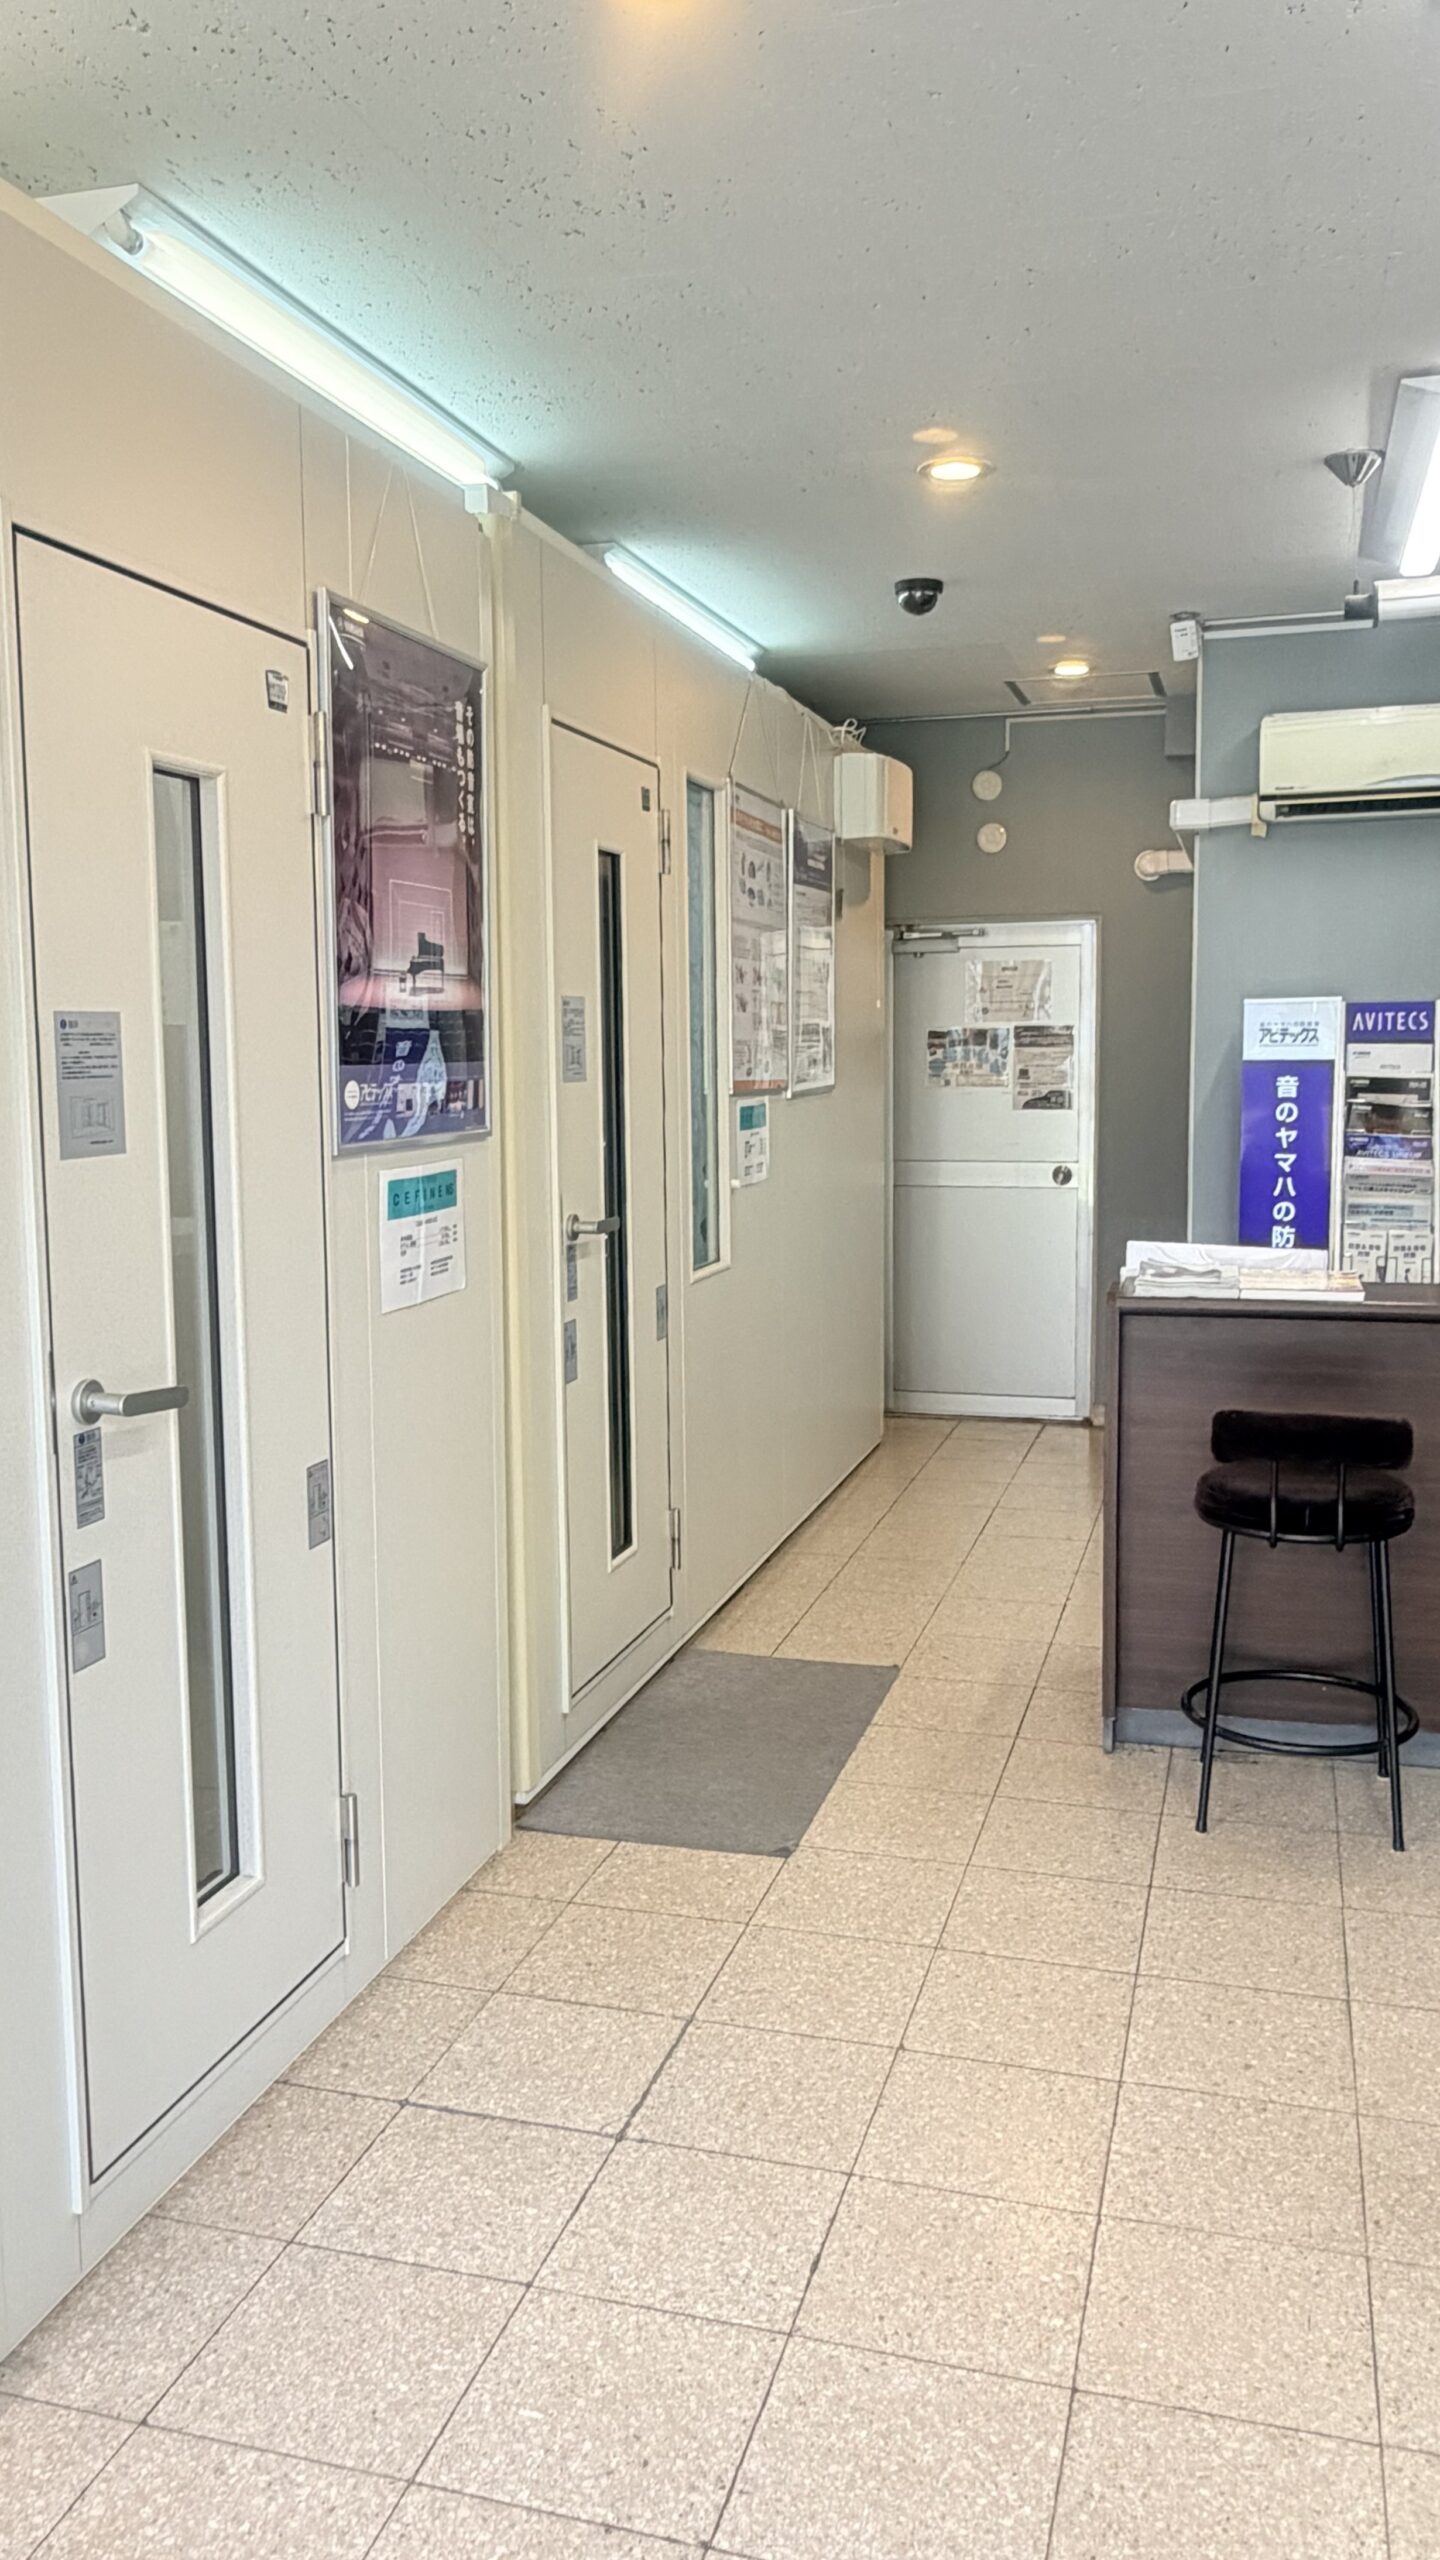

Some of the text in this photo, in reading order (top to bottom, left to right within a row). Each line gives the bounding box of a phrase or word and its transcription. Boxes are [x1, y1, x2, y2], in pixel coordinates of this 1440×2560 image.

[1352, 1010, 1429, 1032] AVITECS
[1258, 1028, 1320, 1044] アビテックス
[1270, 1075, 1300, 1249] 音のヤマハの防
